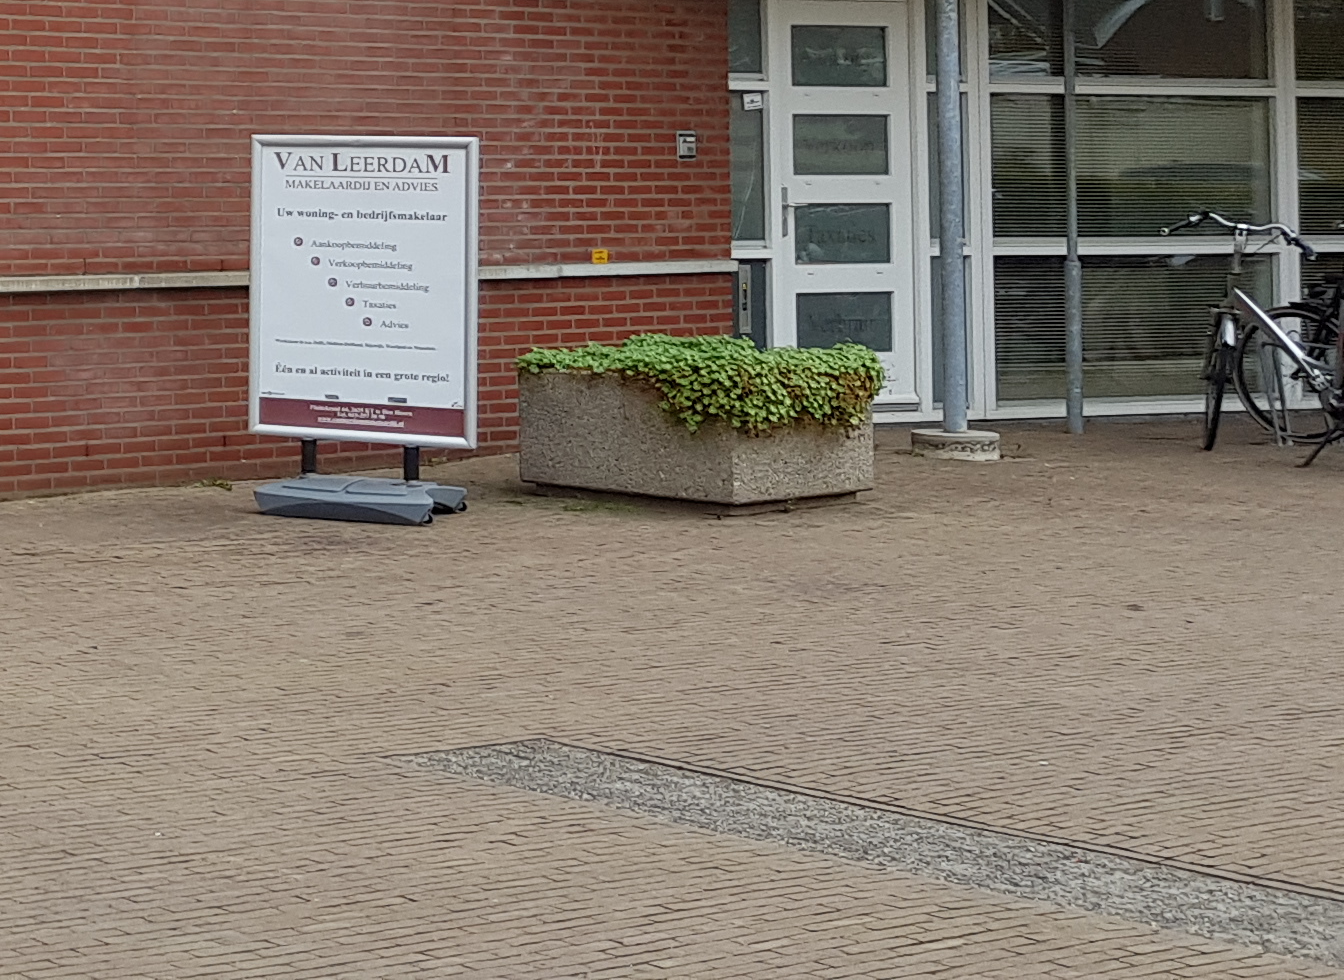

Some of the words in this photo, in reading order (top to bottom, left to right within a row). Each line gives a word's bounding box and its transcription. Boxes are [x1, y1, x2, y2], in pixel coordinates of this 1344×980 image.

[274, 151, 324, 172] VAN
[331, 152, 451, 174] LEERDAM
[285, 179, 371, 191] MAKELAARDIJ
[374, 181, 390, 191] EN
[392, 181, 439, 192] ADVIES
[277, 207, 294, 217] Uw
[296, 209, 339, 221] woning-
[341, 211, 353, 219] en
[356, 209, 448, 222] bedrijfsmakelaar
[328, 258, 413, 271] Verkoopbemiddeling
[380, 320, 409, 329] Advies
[309, 365, 318, 374] al
[320, 367, 361, 378] activiteit
[363, 369, 372, 378] in
[375, 371, 391, 379] een
[394, 372, 420, 382] grote
[421, 373, 450, 383] regio!
